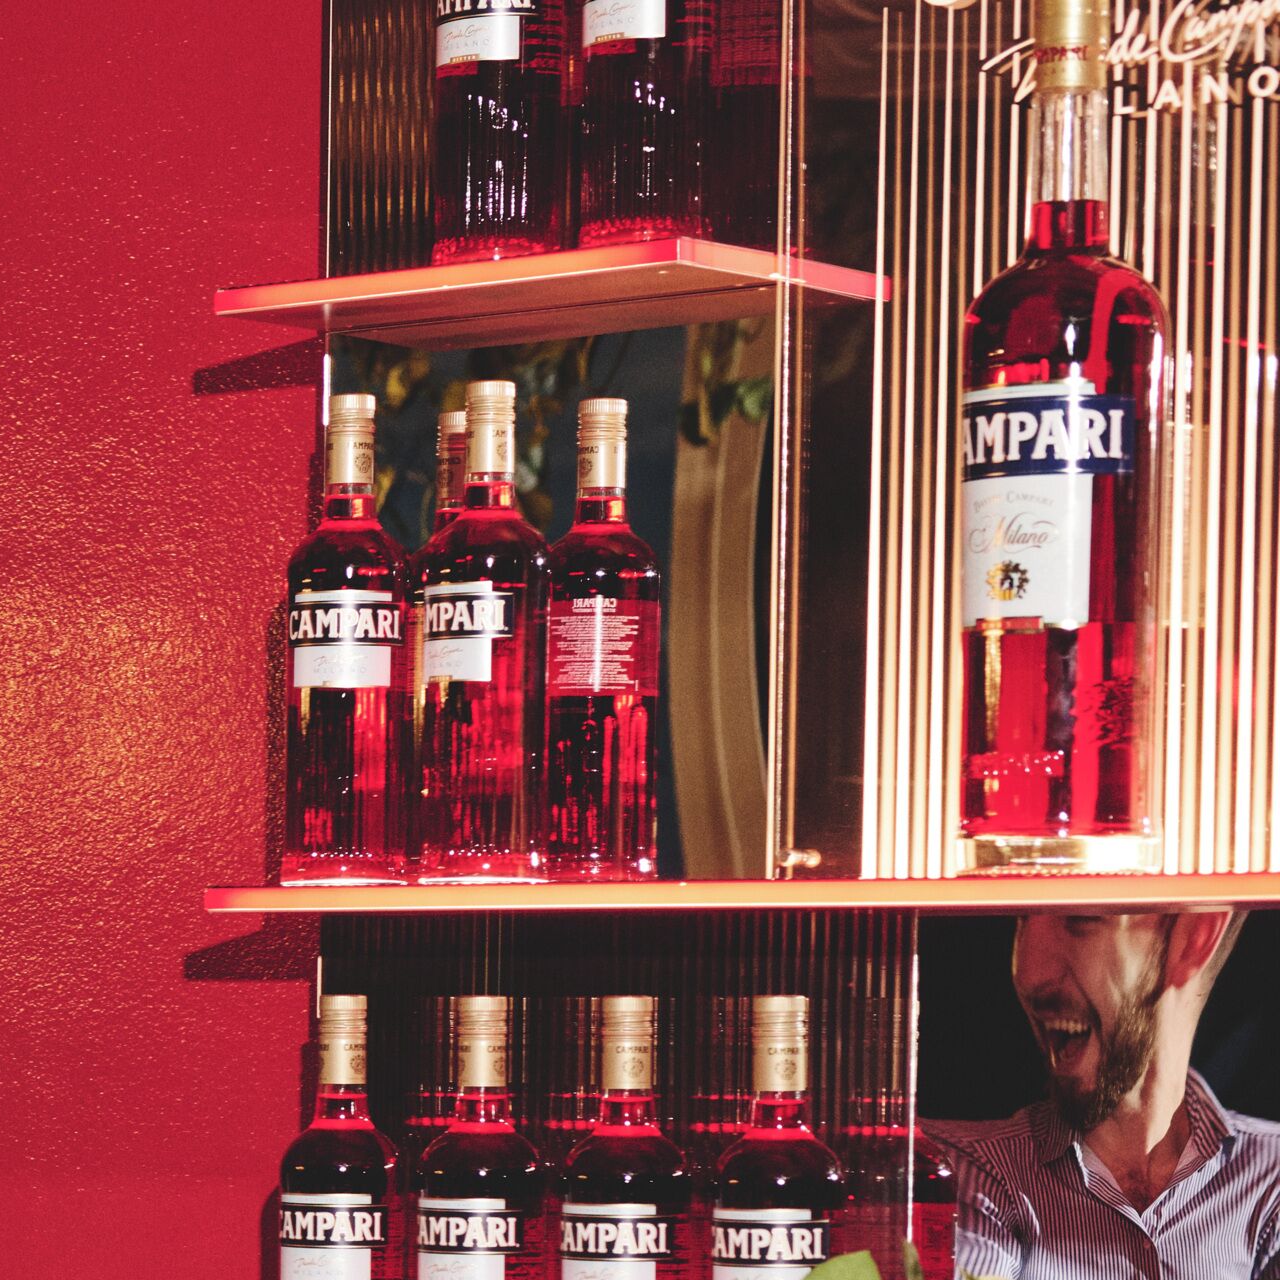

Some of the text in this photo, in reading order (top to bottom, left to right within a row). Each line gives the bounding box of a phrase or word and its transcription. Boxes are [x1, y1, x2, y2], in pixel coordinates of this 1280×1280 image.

[1113, 70, 1279, 115] LANO
[963, 409, 1124, 466] AMPARI
[290, 608, 401, 641] CAMPARI
[424, 599, 507, 634] MPARI
[281, 1211, 382, 1241] AMPARI
[419, 1216, 517, 1247] AMPARI
[561, 1223, 668, 1254] AMPARI
[713, 1228, 824, 1260] AMPARI
